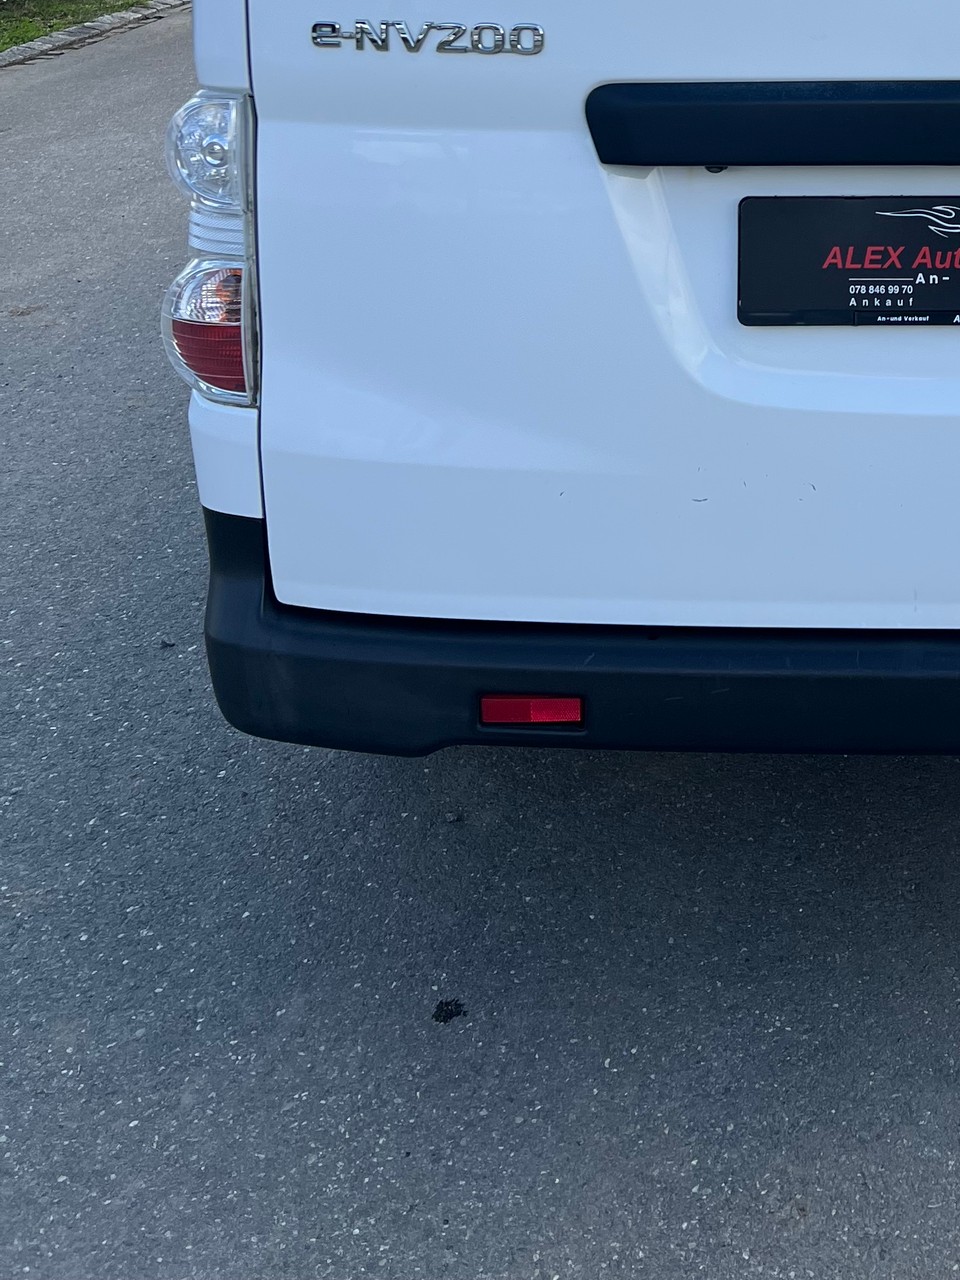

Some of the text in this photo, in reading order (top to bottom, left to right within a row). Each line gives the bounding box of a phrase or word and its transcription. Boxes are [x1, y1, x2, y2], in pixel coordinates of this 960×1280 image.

[311, 19, 544, 55] e-NV200
[822, 246, 905, 269] ALEX
[915, 273, 950, 284] An-
[849, 285, 913, 294] 078 846 99 70
[849, 297, 914, 307] Ankauf
